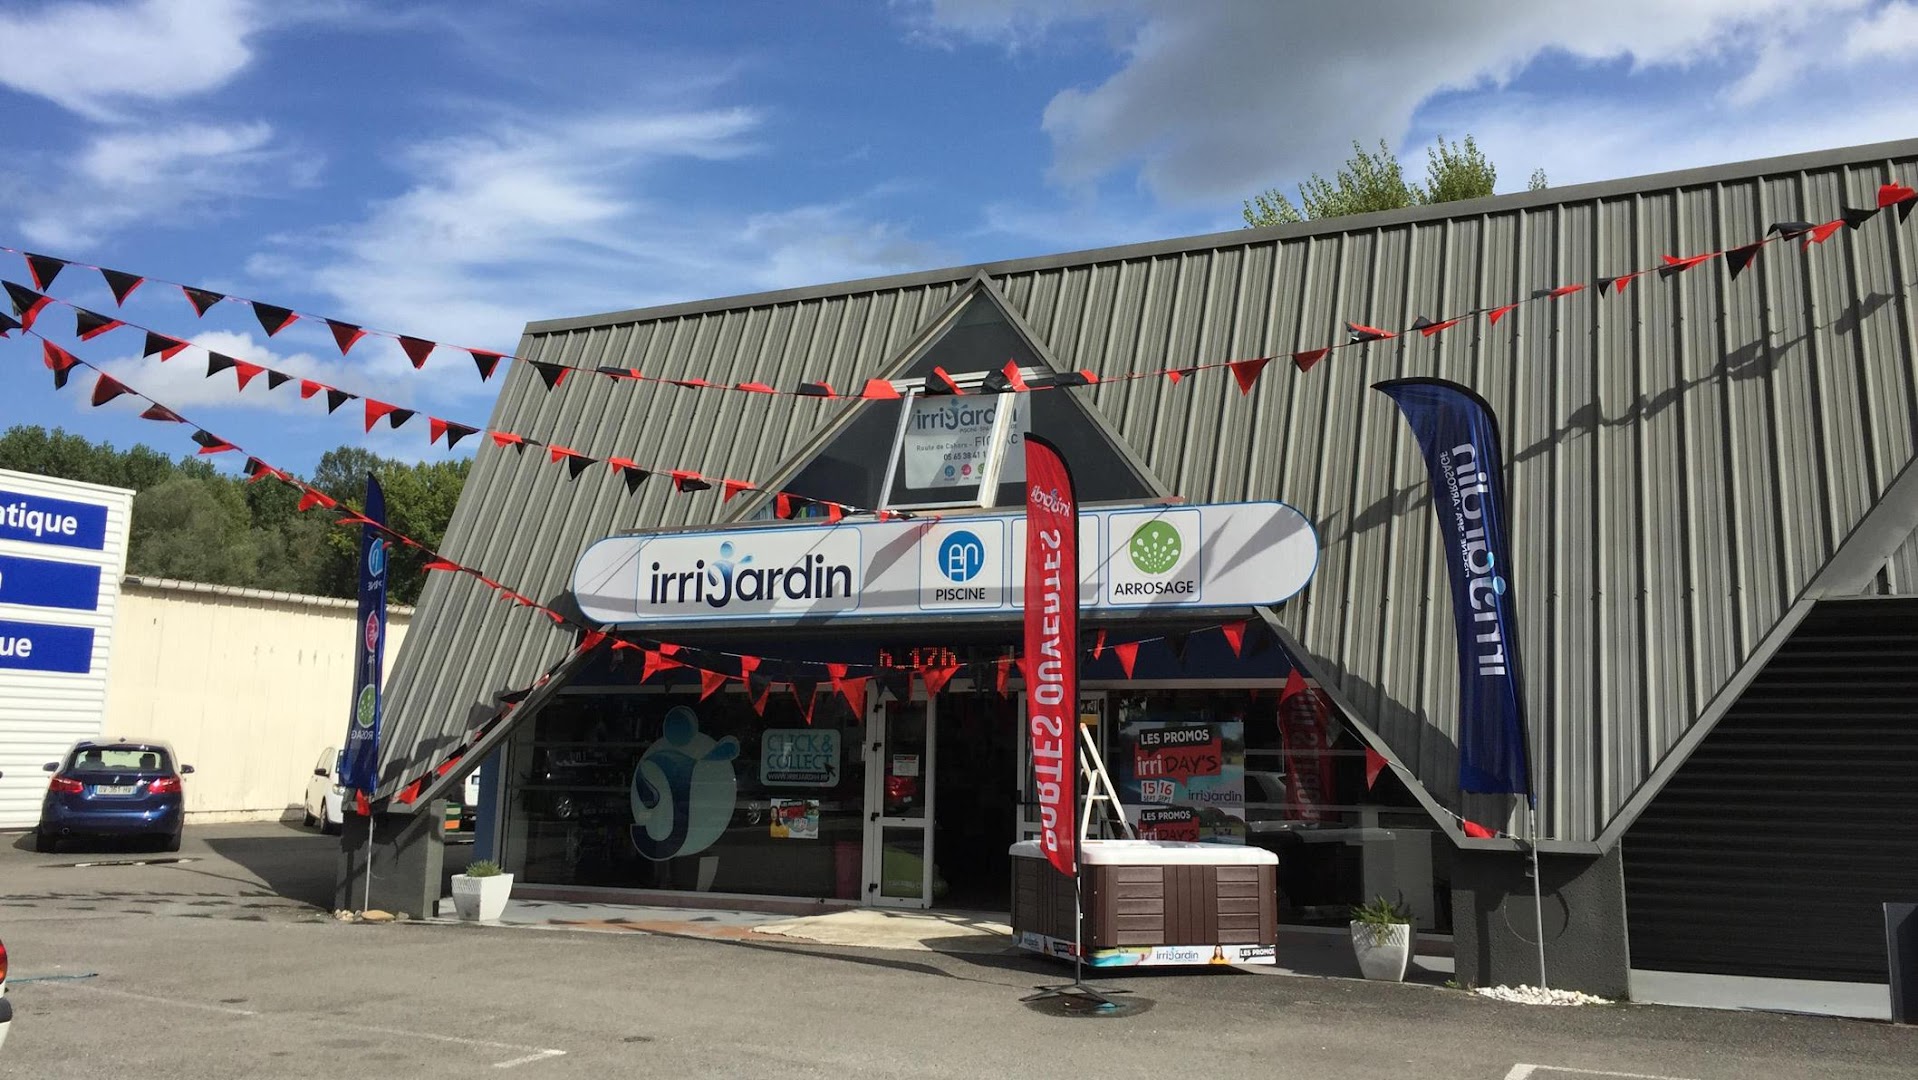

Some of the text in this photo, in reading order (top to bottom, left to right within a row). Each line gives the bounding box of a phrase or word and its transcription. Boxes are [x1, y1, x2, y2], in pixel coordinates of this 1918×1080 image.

[953, 452, 962, 460] 65
[963, 451, 972, 459] 38
[0, 502, 78, 537] tique
[935, 587, 986, 601] PISCINE
[1114, 580, 1194, 596] ARROSAGE
[767, 734, 833, 753] CLICK &
[1141, 729, 1210, 745] LES PROMOS
[766, 753, 832, 770] COLLECT
[1137, 754, 1163, 776] irri
[1142, 781, 1173, 796] 15 16
[1142, 810, 1191, 821] LES PROMOS
[1241, 949, 1251, 957] LES
